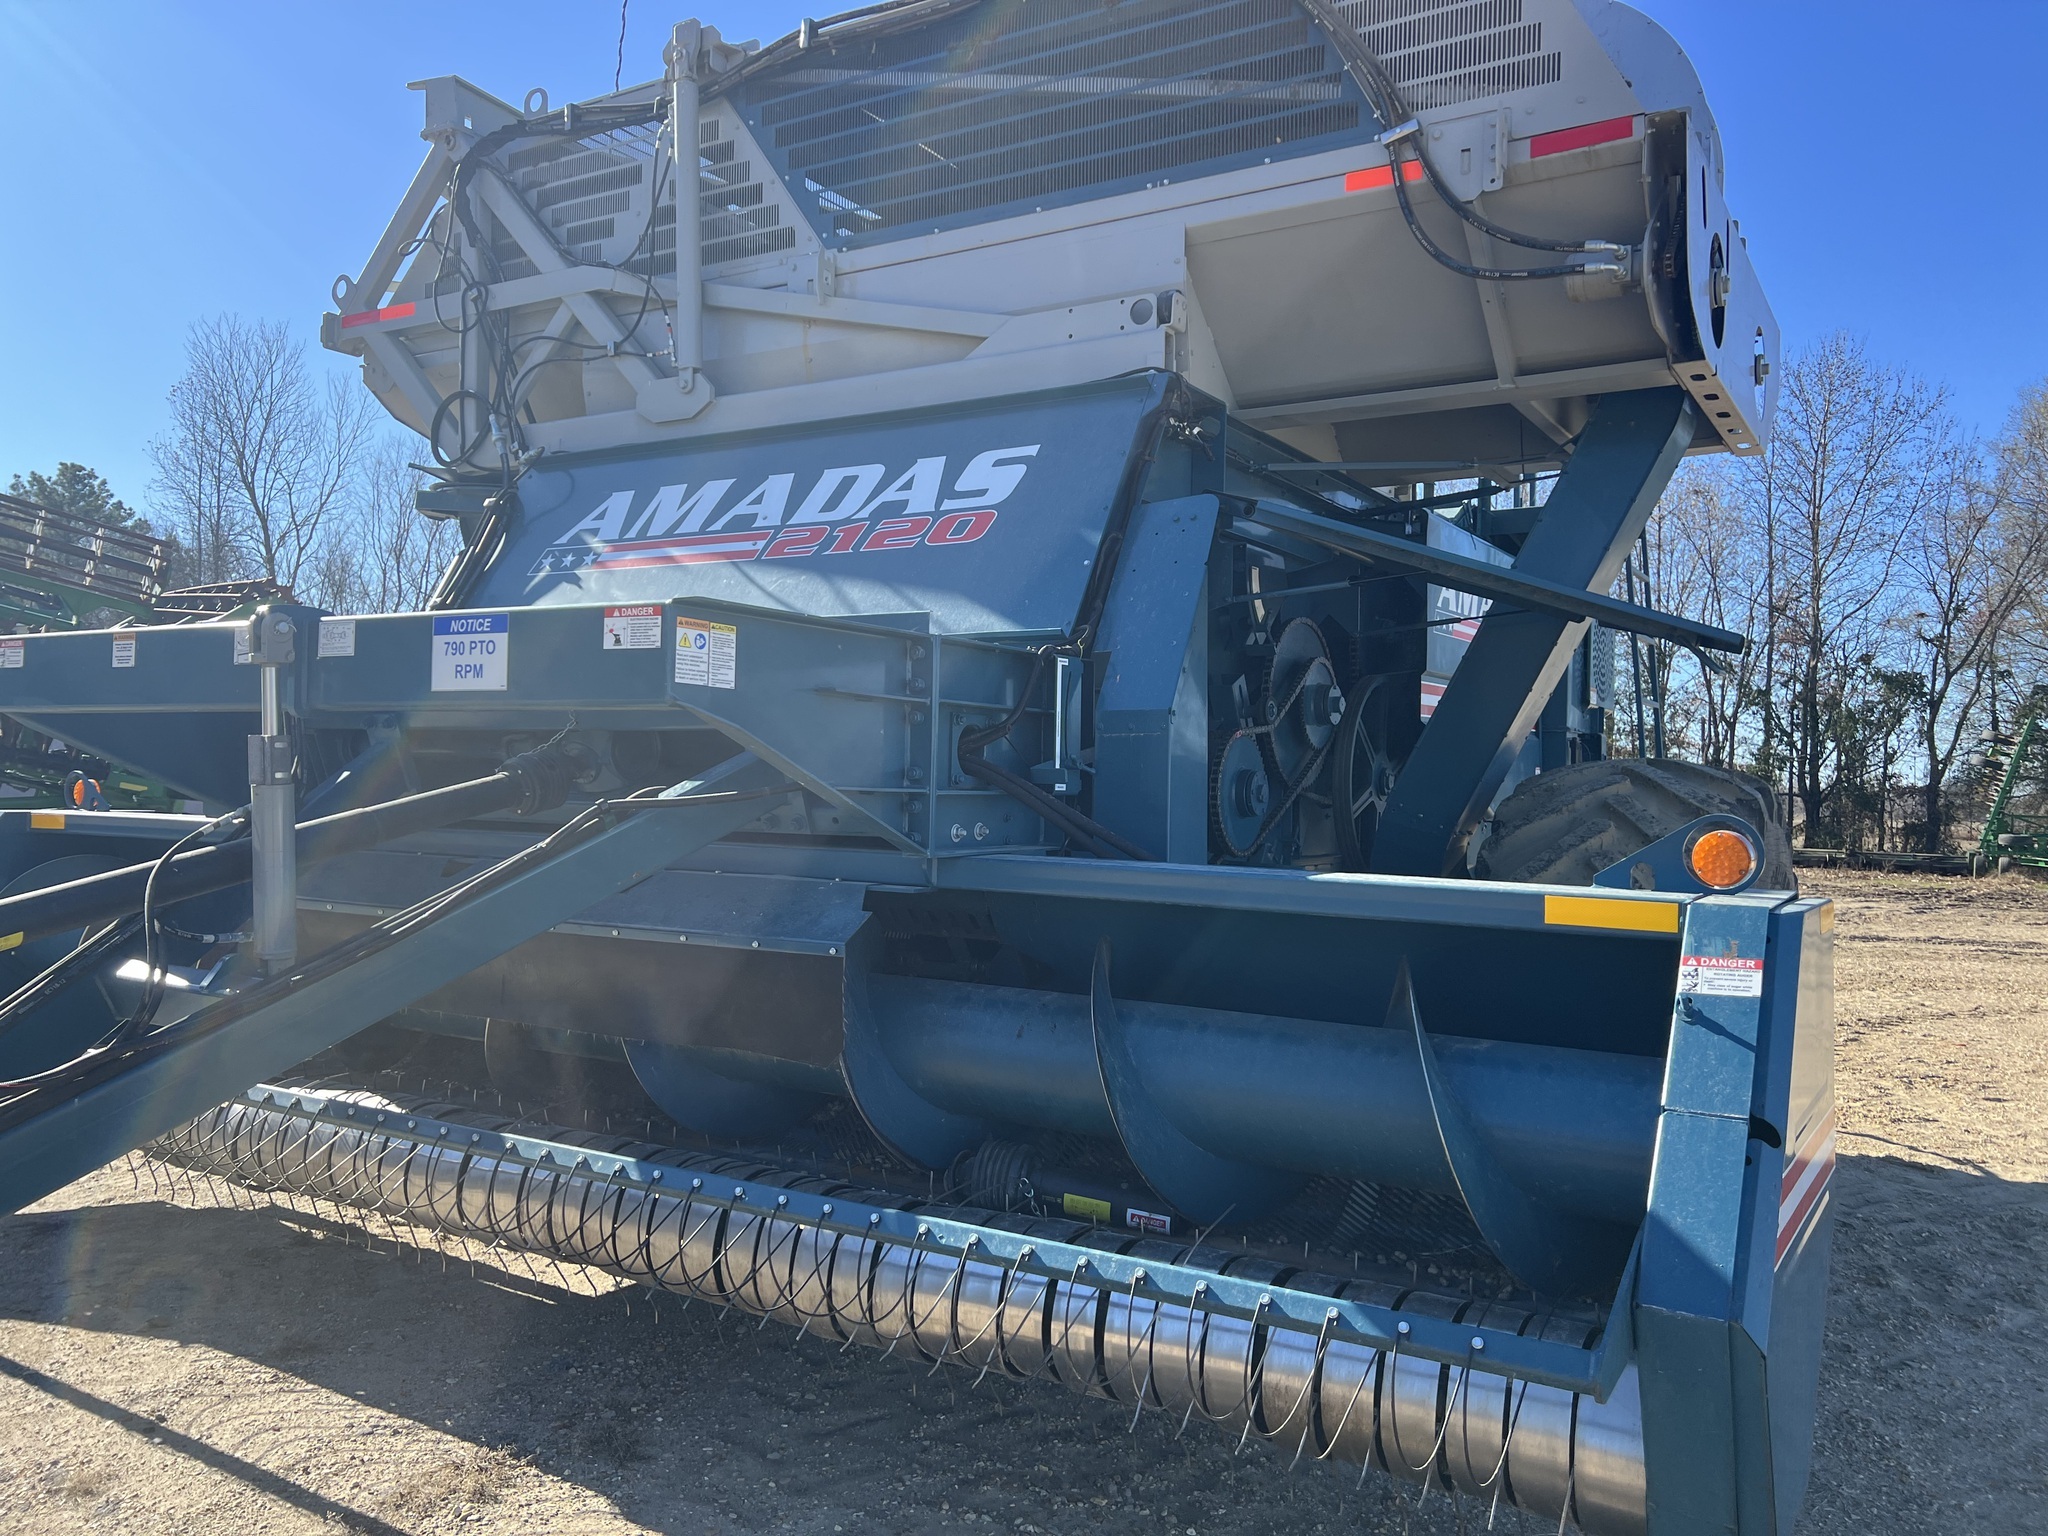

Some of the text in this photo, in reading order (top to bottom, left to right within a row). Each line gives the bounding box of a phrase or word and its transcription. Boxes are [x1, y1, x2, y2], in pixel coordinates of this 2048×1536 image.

[554, 444, 1041, 545] AMADAS
[762, 509, 999, 560] 2120
[621, 607, 654, 617] DANGER
[450, 618, 492, 633] NOTICE
[684, 620, 709, 629] WARNING
[714, 624, 735, 632] CAUTION
[444, 640, 496, 656] 790 PTO
[454, 664, 484, 679] RPM
[1700, 958, 1756, 968] DANGER
